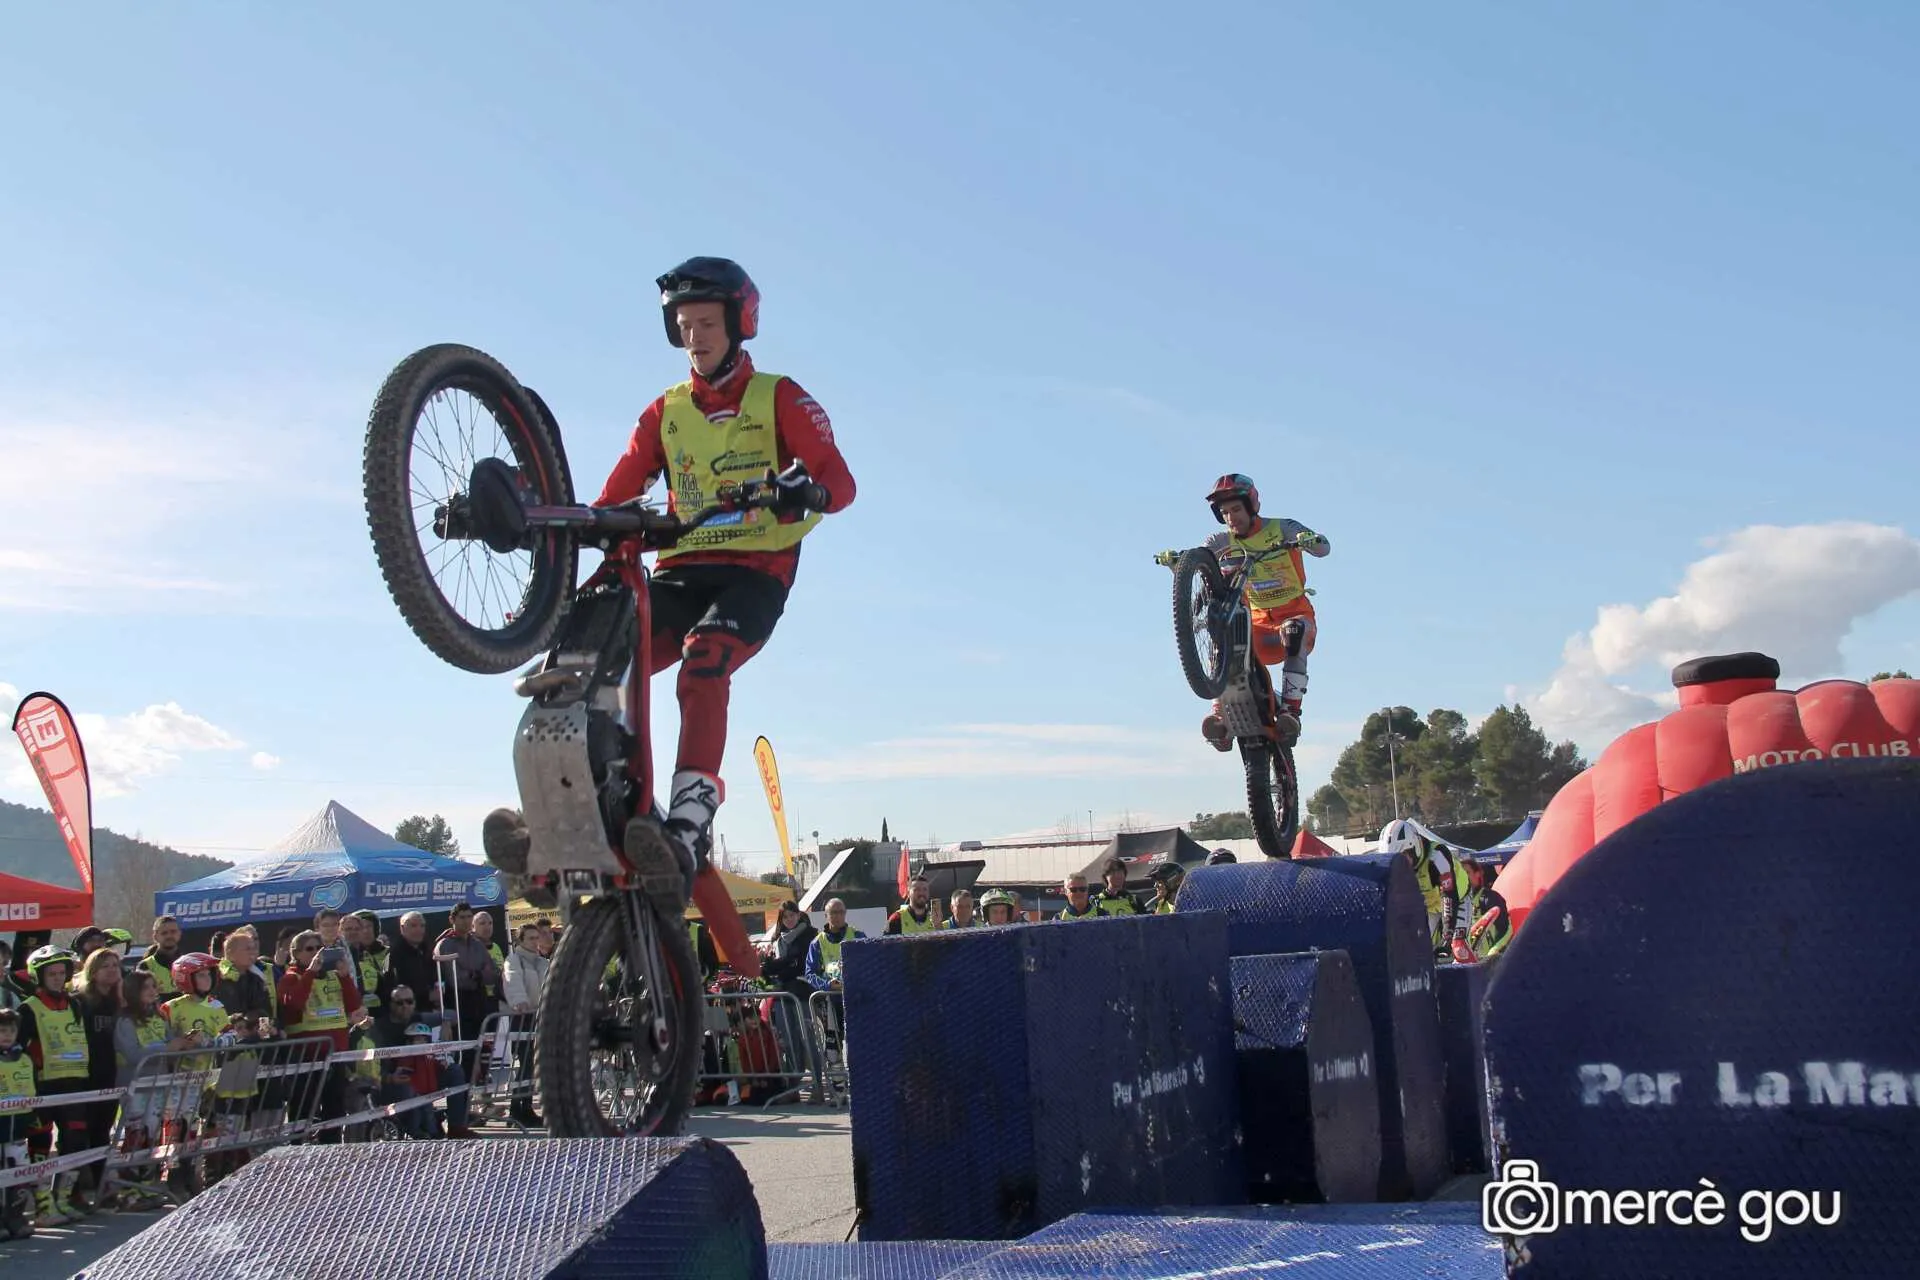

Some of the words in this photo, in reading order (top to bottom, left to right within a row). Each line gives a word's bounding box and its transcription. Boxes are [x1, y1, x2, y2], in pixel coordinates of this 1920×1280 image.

[1733, 748, 1823, 774] MOTO
[1831, 740, 1911, 758] CLUB
[365, 881, 428, 897] Custom
[433, 879, 473, 894] Gear
[162, 897, 244, 917] Custom
[251, 892, 304, 908] Gear
[1578, 1063, 1682, 1105] Per
[1716, 1061, 1791, 1106] La
